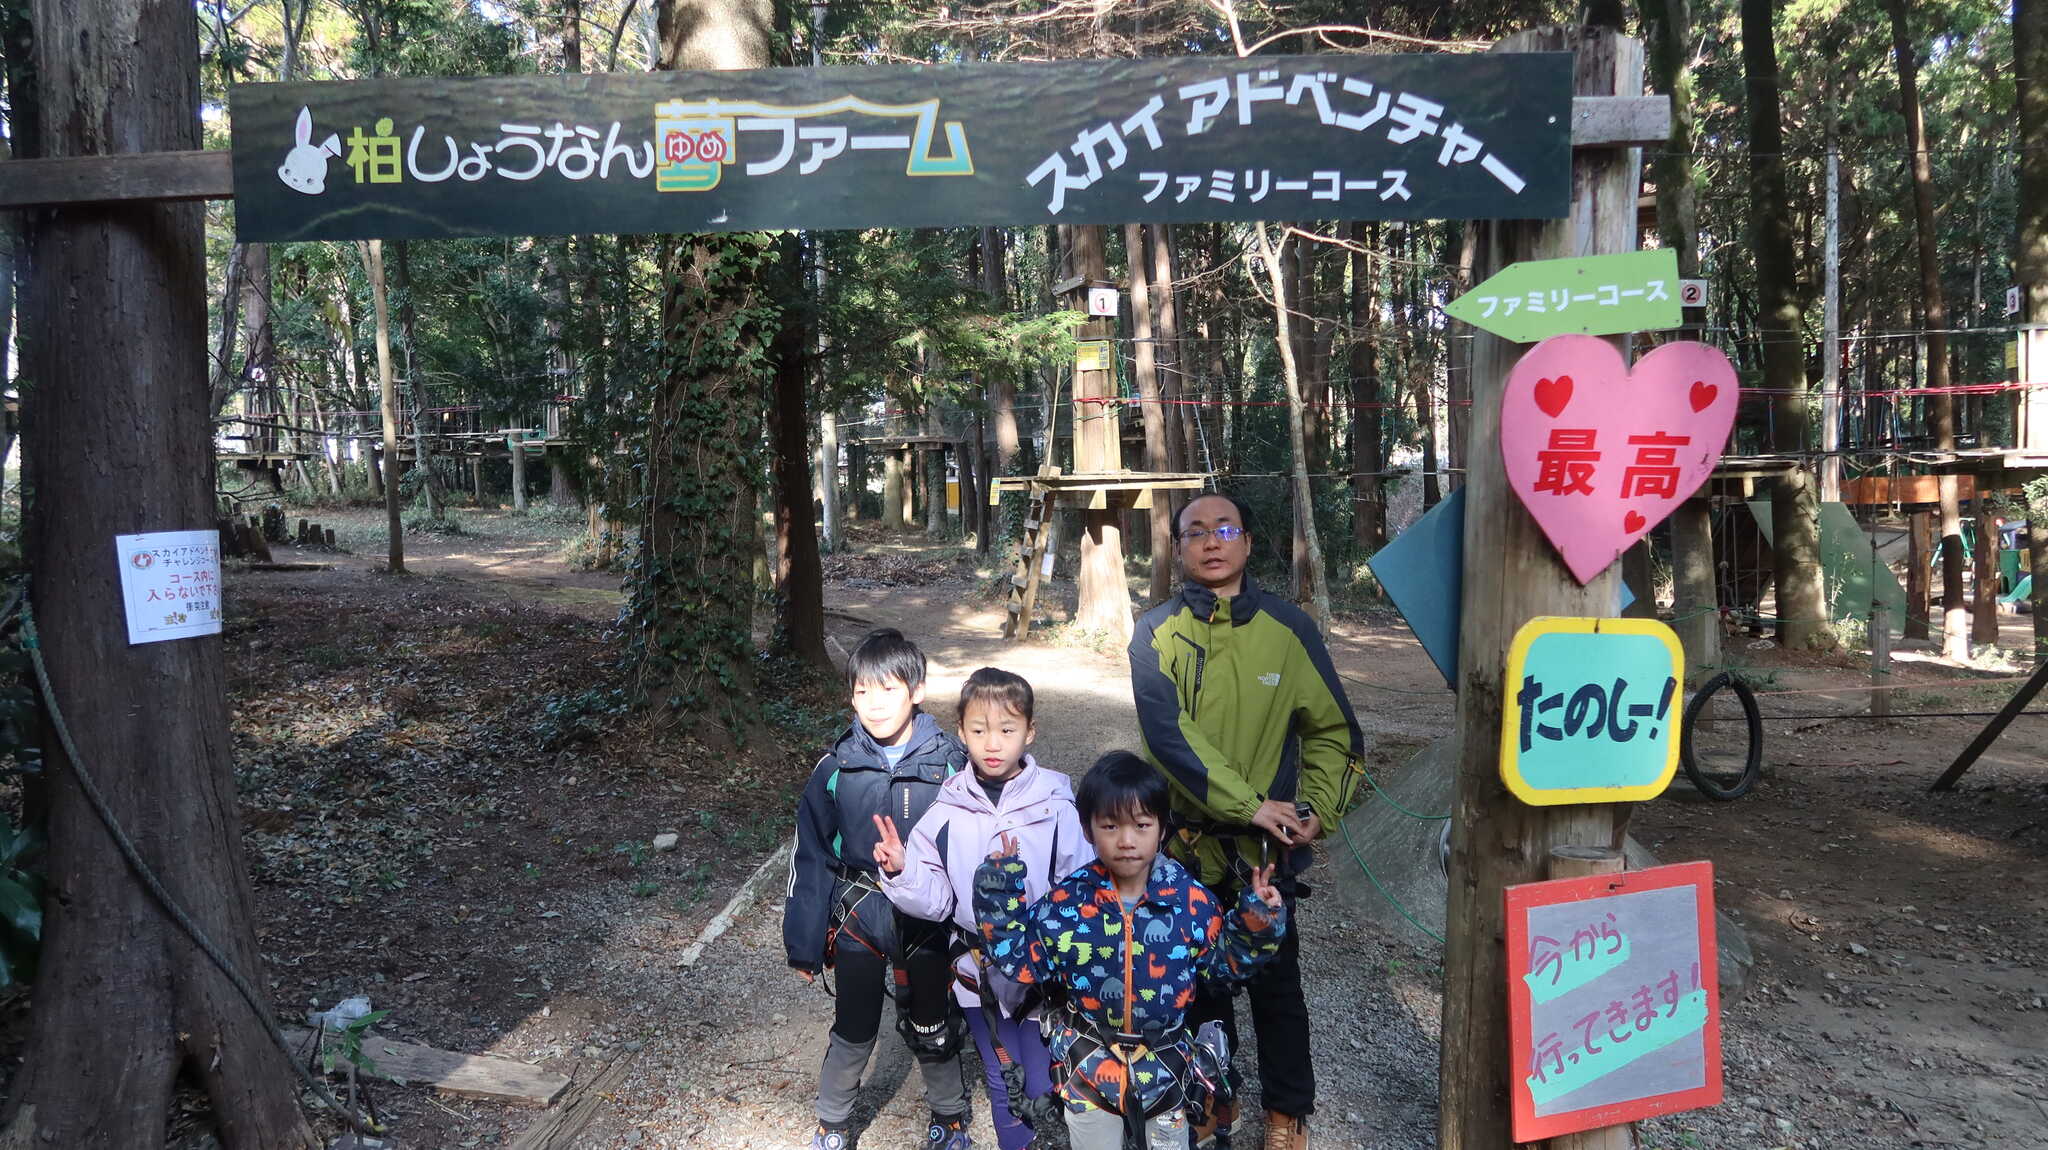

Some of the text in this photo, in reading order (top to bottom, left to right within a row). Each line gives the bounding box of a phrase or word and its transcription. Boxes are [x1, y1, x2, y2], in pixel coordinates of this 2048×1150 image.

[1139, 170, 1412, 204] ファミリーコース
[1477, 279, 1669, 319] ファミリーコース
[1686, 287, 1697, 301] 2
[1533, 429, 1690, 499] 最高
[1529, 912, 1623, 986] 今から
